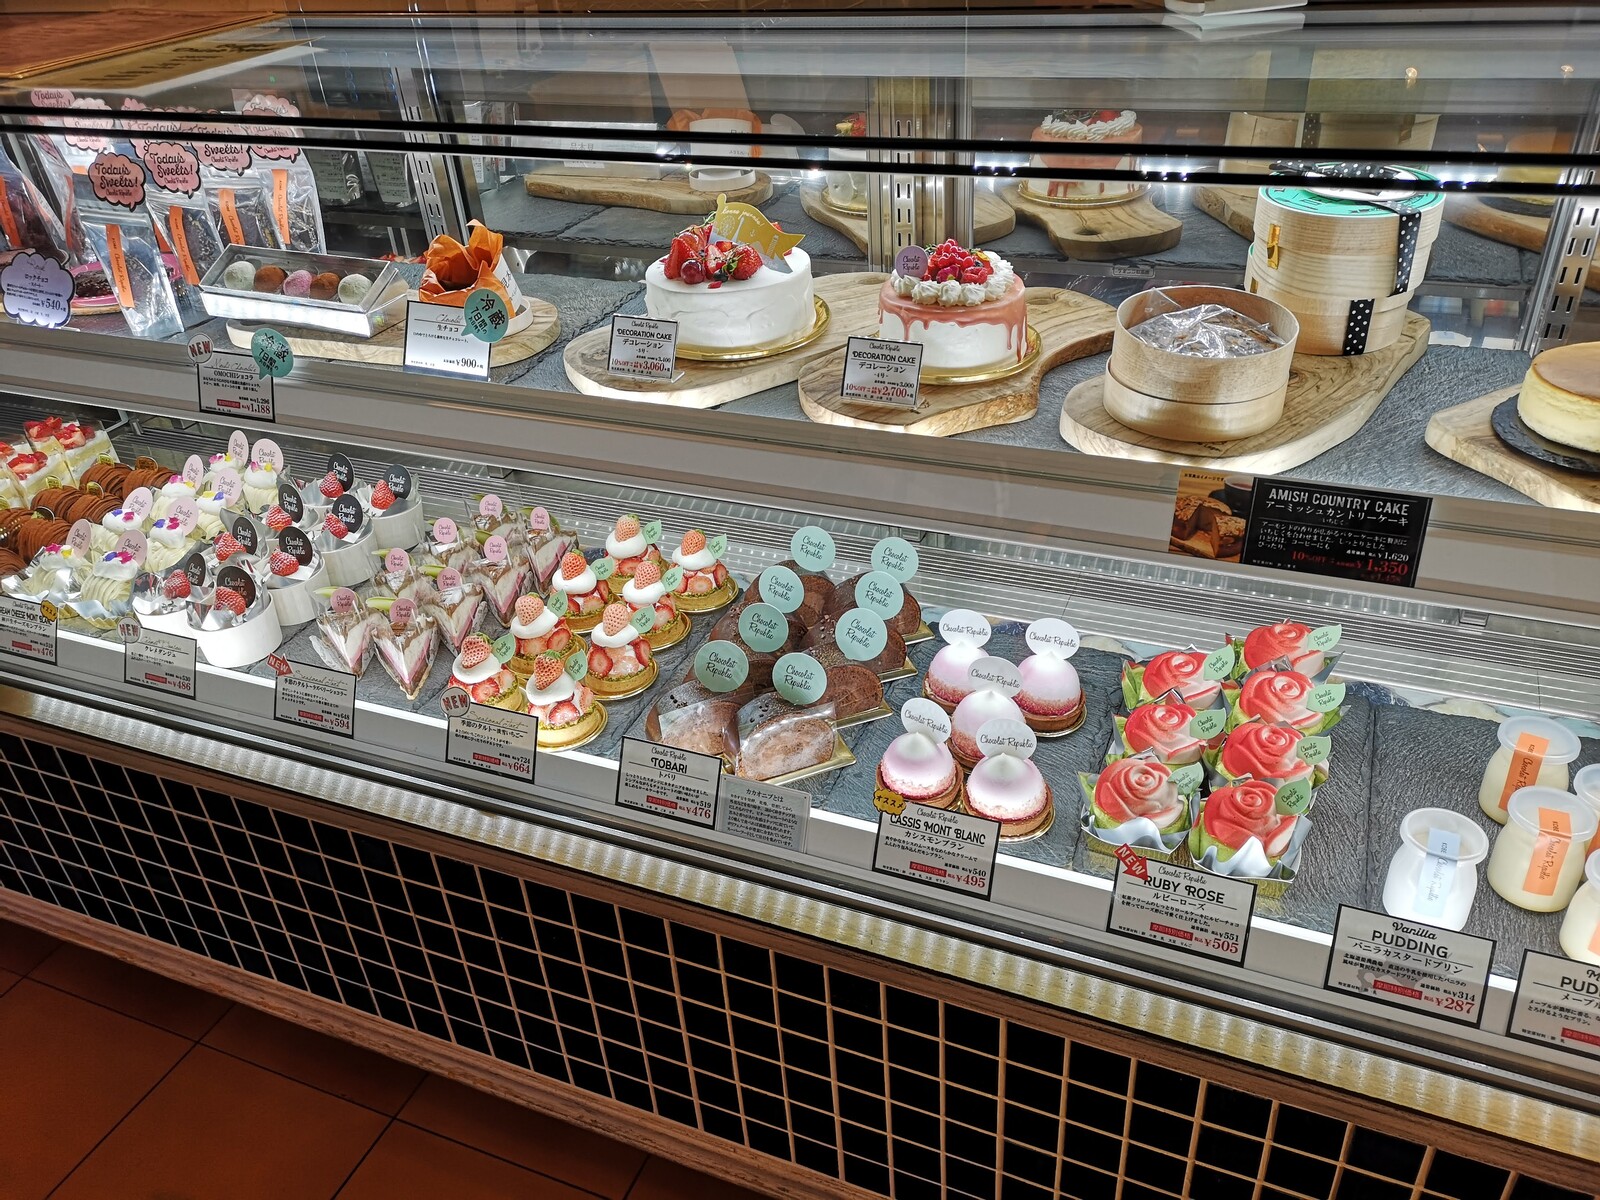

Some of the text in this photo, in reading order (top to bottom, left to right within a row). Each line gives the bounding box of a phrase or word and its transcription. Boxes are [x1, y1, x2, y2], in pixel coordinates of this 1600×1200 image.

[150, 152, 187, 165] Today's
[204, 143, 244, 157] Sweets!
[95, 163, 131, 177] Today's
[157, 164, 193, 178] Sweets!
[100, 176, 138, 189] Sweets!
[480, 293, 506, 330] 冷蔵
[617, 328, 672, 341] DECORATION CAKE
[188, 340, 212, 358] NEW
[623, 338, 664, 349] デコレーション
[456, 357, 477, 368] ¥900
[852, 350, 916, 364] DECORATION CAKE
[859, 362, 906, 374] デコレーション
[1269, 488, 1410, 516] AMISH COUNTRY CAKE
[1265, 500, 1409, 527] アーミッシュカントリーケーキ
[802, 535, 826, 551] Chocolat
[799, 544, 823, 560] Republic
[883, 546, 909, 563] Chocolat
[1377, 552, 1409, 562] ¥1,620
[880, 555, 905, 572] Republic
[770, 575, 794, 593] Chocolat
[868, 580, 895, 599] Chocolat
[767, 584, 791, 602] Republic
[865, 589, 890, 608] Republic
[751, 612, 779, 630] Chocolat
[850, 618, 878, 639] Chocolat
[119, 623, 139, 637] NEW
[748, 622, 775, 640] Republic
[845, 628, 871, 649] Republic
[942, 623, 989, 638] Chocolat Republic
[1029, 631, 1078, 649] Chocolat Republic
[269, 655, 289, 673] NEW
[708, 651, 738, 669] Chocolat
[705, 662, 733, 680] Republic
[785, 664, 815, 681] Chocolat
[970, 668, 1021, 689] Chocolat Republic
[783, 675, 813, 691] Republic
[442, 694, 468, 711] NEW
[329, 718, 350, 730] ¥594
[904, 709, 949, 734] Chocolat Republic
[979, 734, 1034, 750] Chocolat Republic
[507, 762, 531, 775] ¥664
[650, 757, 688, 774] TOBARI
[659, 771, 676, 781] トバリ
[876, 794, 904, 809] オススメ
[686, 806, 712, 819] ¥476
[889, 814, 986, 845] CASSIS MONT BLANC
[904, 830, 965, 850] カシスモンブラン
[1118, 846, 1146, 876] NEW
[955, 874, 986, 889] ¥495
[1143, 875, 1226, 904] RUBY ROSE
[1152, 892, 1206, 911] ルビーローズ
[1391, 921, 1437, 941] Vanilla
[1204, 938, 1239, 954] ¥505
[1371, 930, 1449, 959] PUDDING
[1352, 941, 1464, 975] バニラカスタードプリン
[1452, 990, 1476, 1002] ¥314
[1435, 997, 1476, 1015] ¥287
